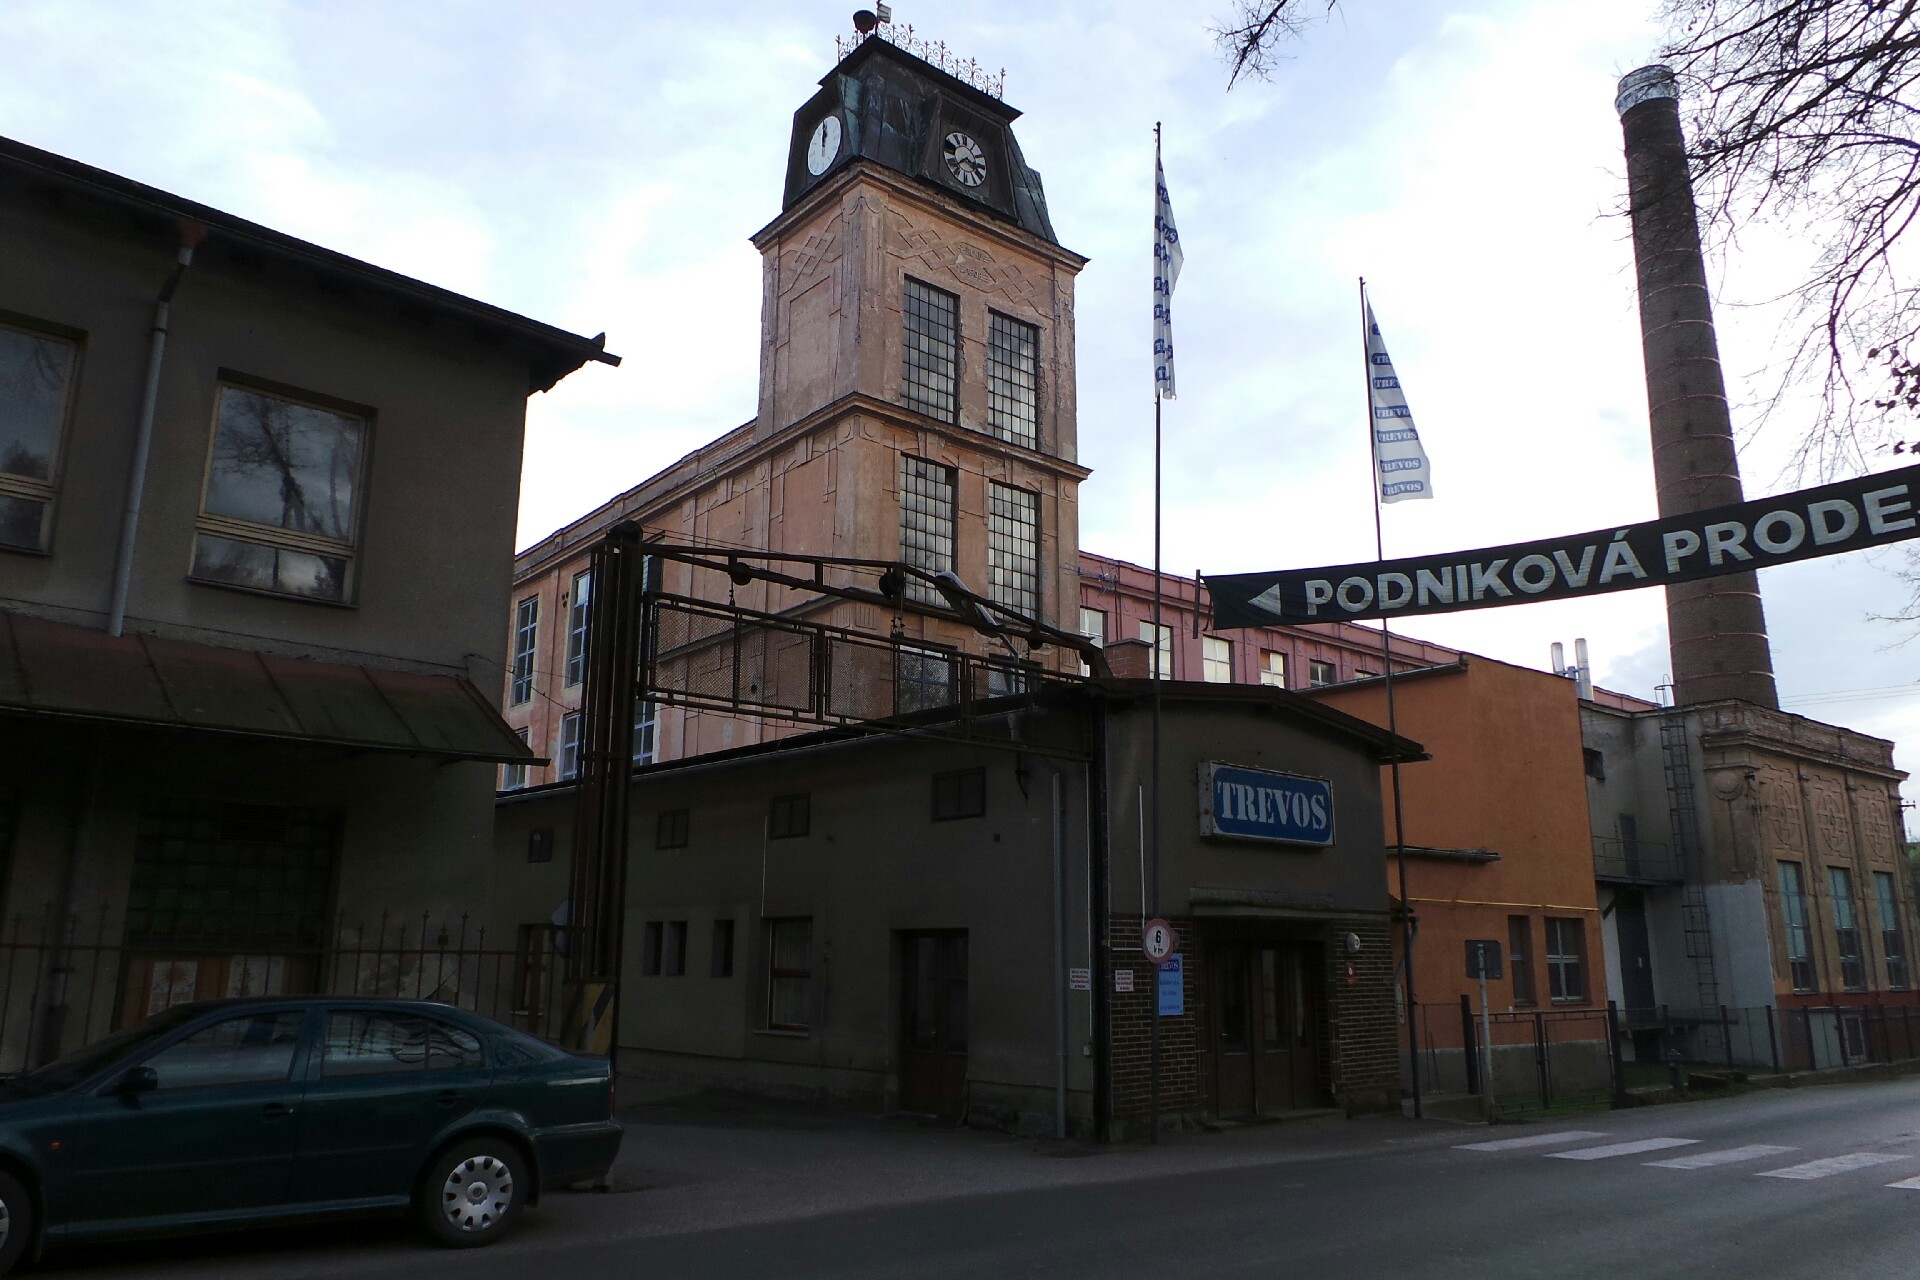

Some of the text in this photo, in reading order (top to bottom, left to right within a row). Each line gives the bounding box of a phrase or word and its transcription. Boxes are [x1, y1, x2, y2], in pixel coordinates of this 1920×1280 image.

[1305, 484, 1920, 615] PODNIKOVÁ PRODE
[1217, 781, 1327, 830] TREVOS
[1156, 930, 1161, 943] 6
